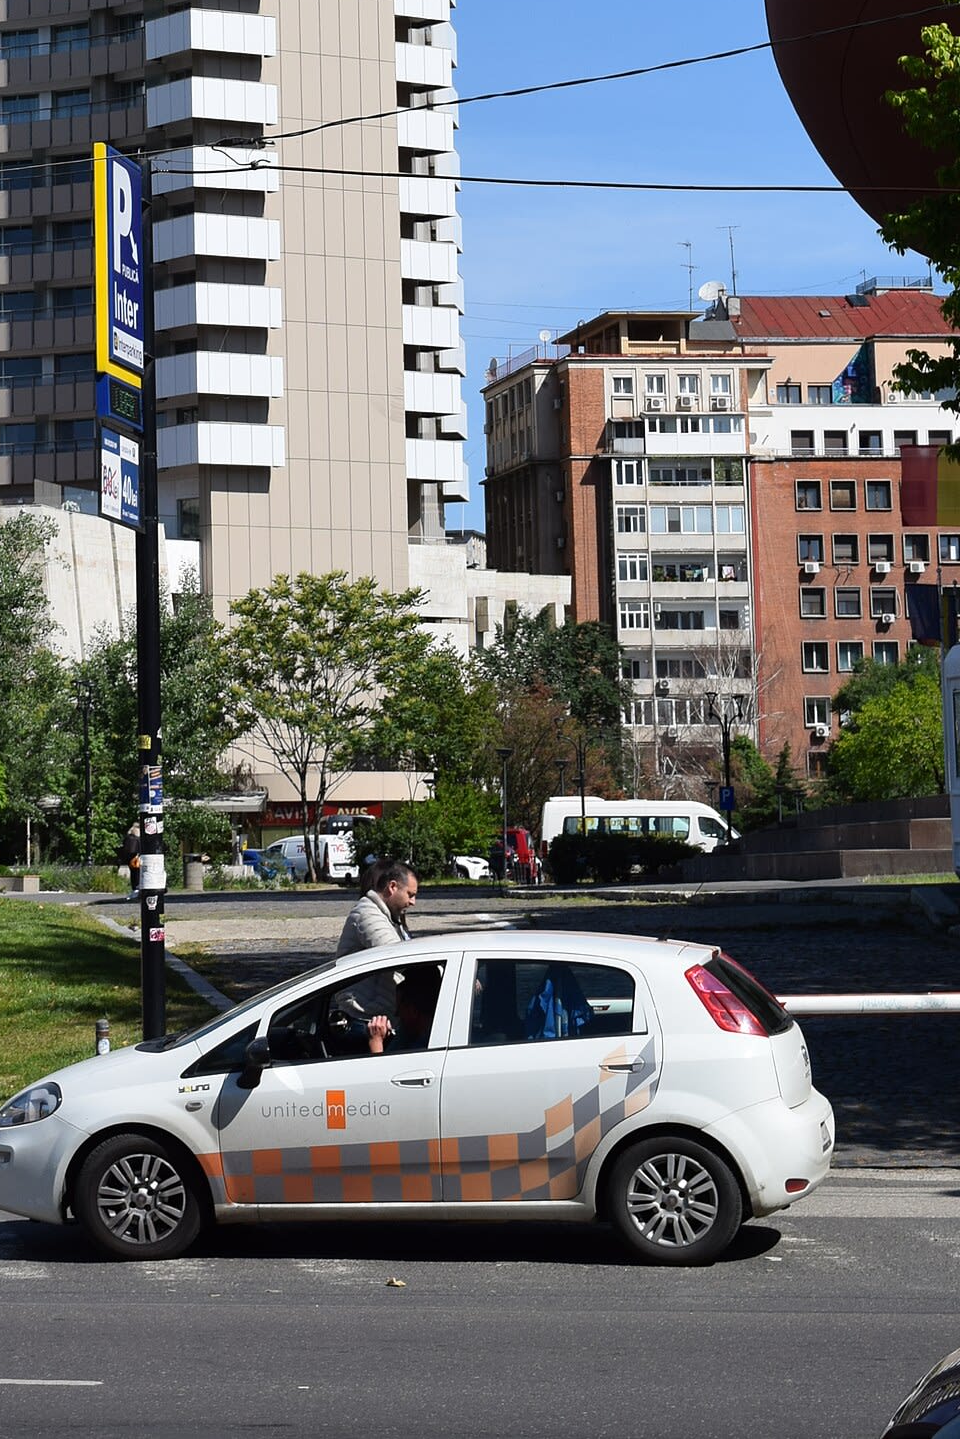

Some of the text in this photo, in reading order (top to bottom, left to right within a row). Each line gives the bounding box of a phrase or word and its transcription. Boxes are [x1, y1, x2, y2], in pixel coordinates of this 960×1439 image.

[112, 160, 133, 274] P
[114, 281, 139, 330] Inter
[123, 474, 132, 505] 40
[722, 789, 731, 802] P
[337, 807, 368, 815] AVIS
[261, 1101, 390, 1118] unitedmedia
